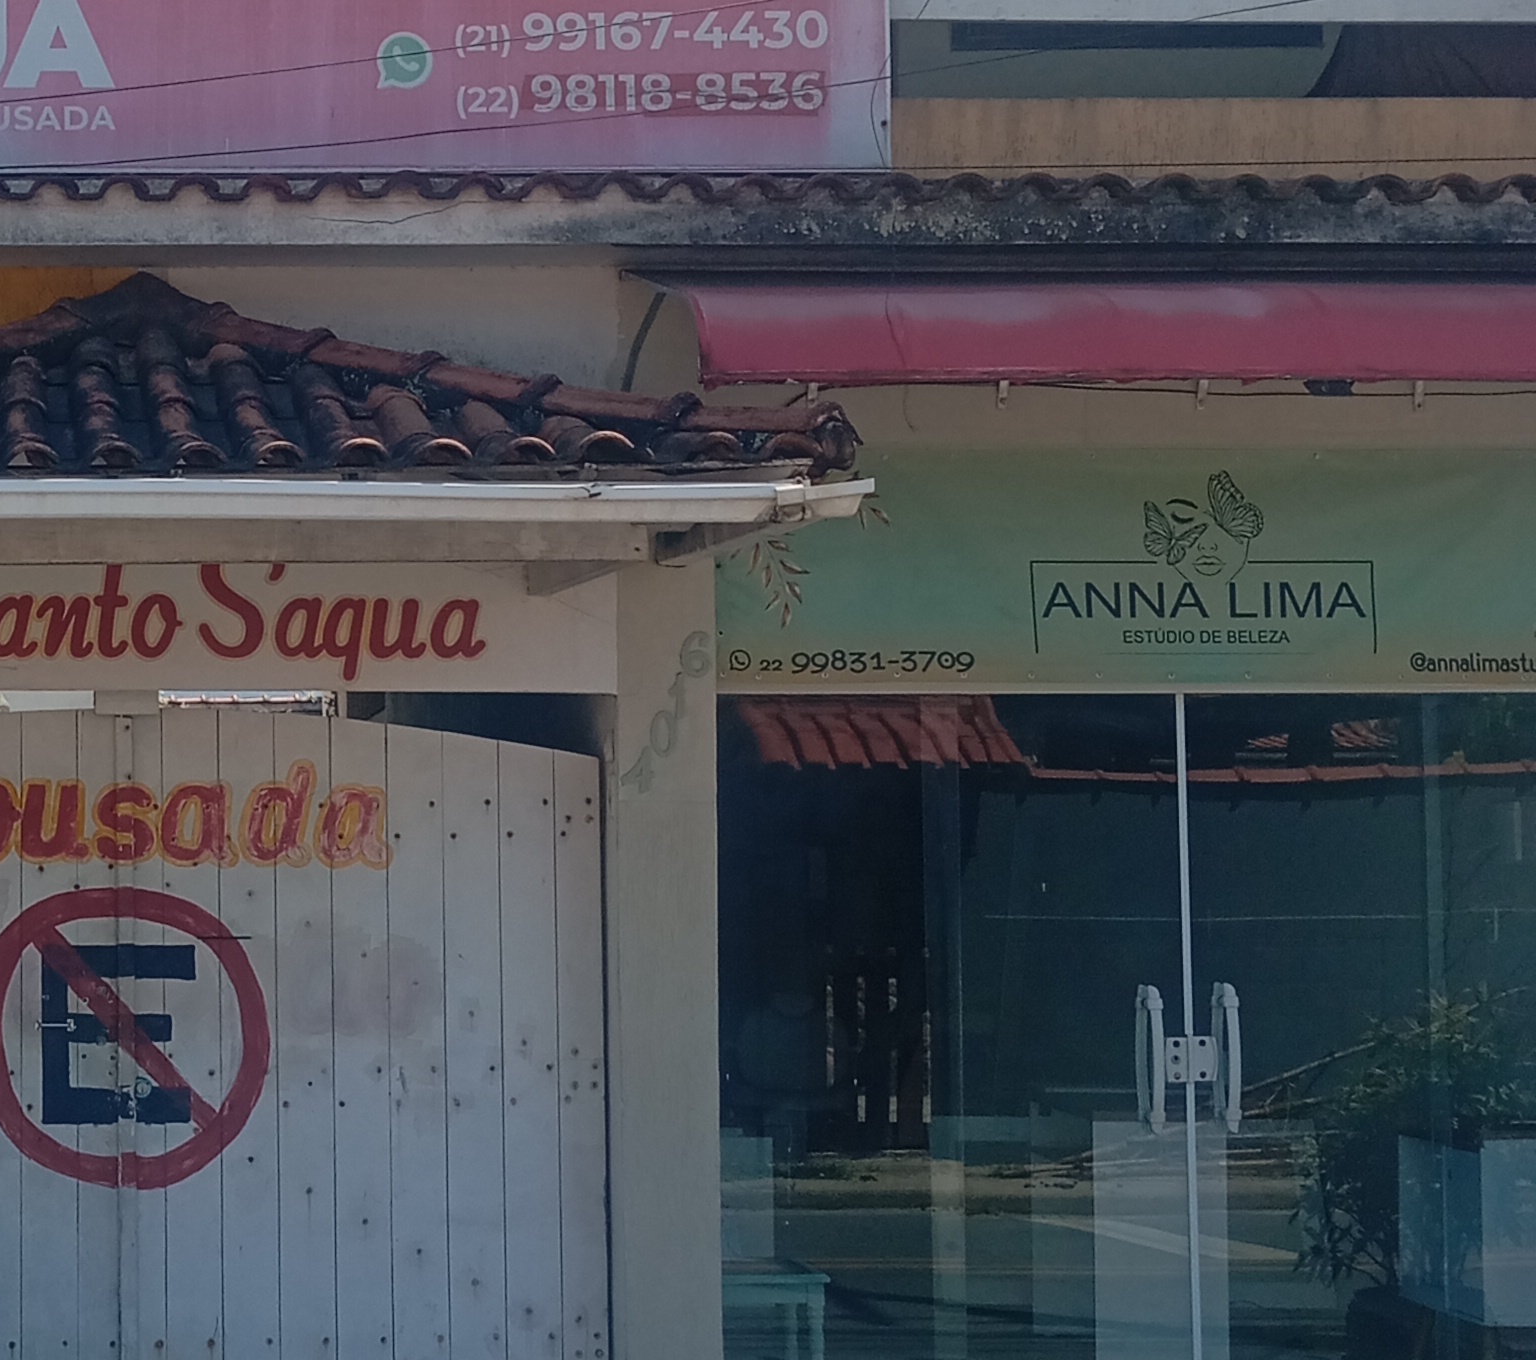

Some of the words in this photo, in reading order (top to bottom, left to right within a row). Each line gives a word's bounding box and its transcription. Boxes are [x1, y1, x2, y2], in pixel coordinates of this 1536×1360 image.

[455, 24, 511, 58] (21)
[521, 10, 829, 50] 99167-4430
[456, 85, 520, 119] (22)
[530, 71, 825, 112] 98118-8536
[1042, 582, 1210, 618] ANNA
[1229, 582, 1367, 618] LIMA
[1123, 628, 1195, 644] ESTÚDIO
[1200, 630, 1222, 644] DE
[1227, 630, 1290, 645] BELEZA
[759, 659, 783, 671] 22
[791, 649, 975, 674] 99831-3709
